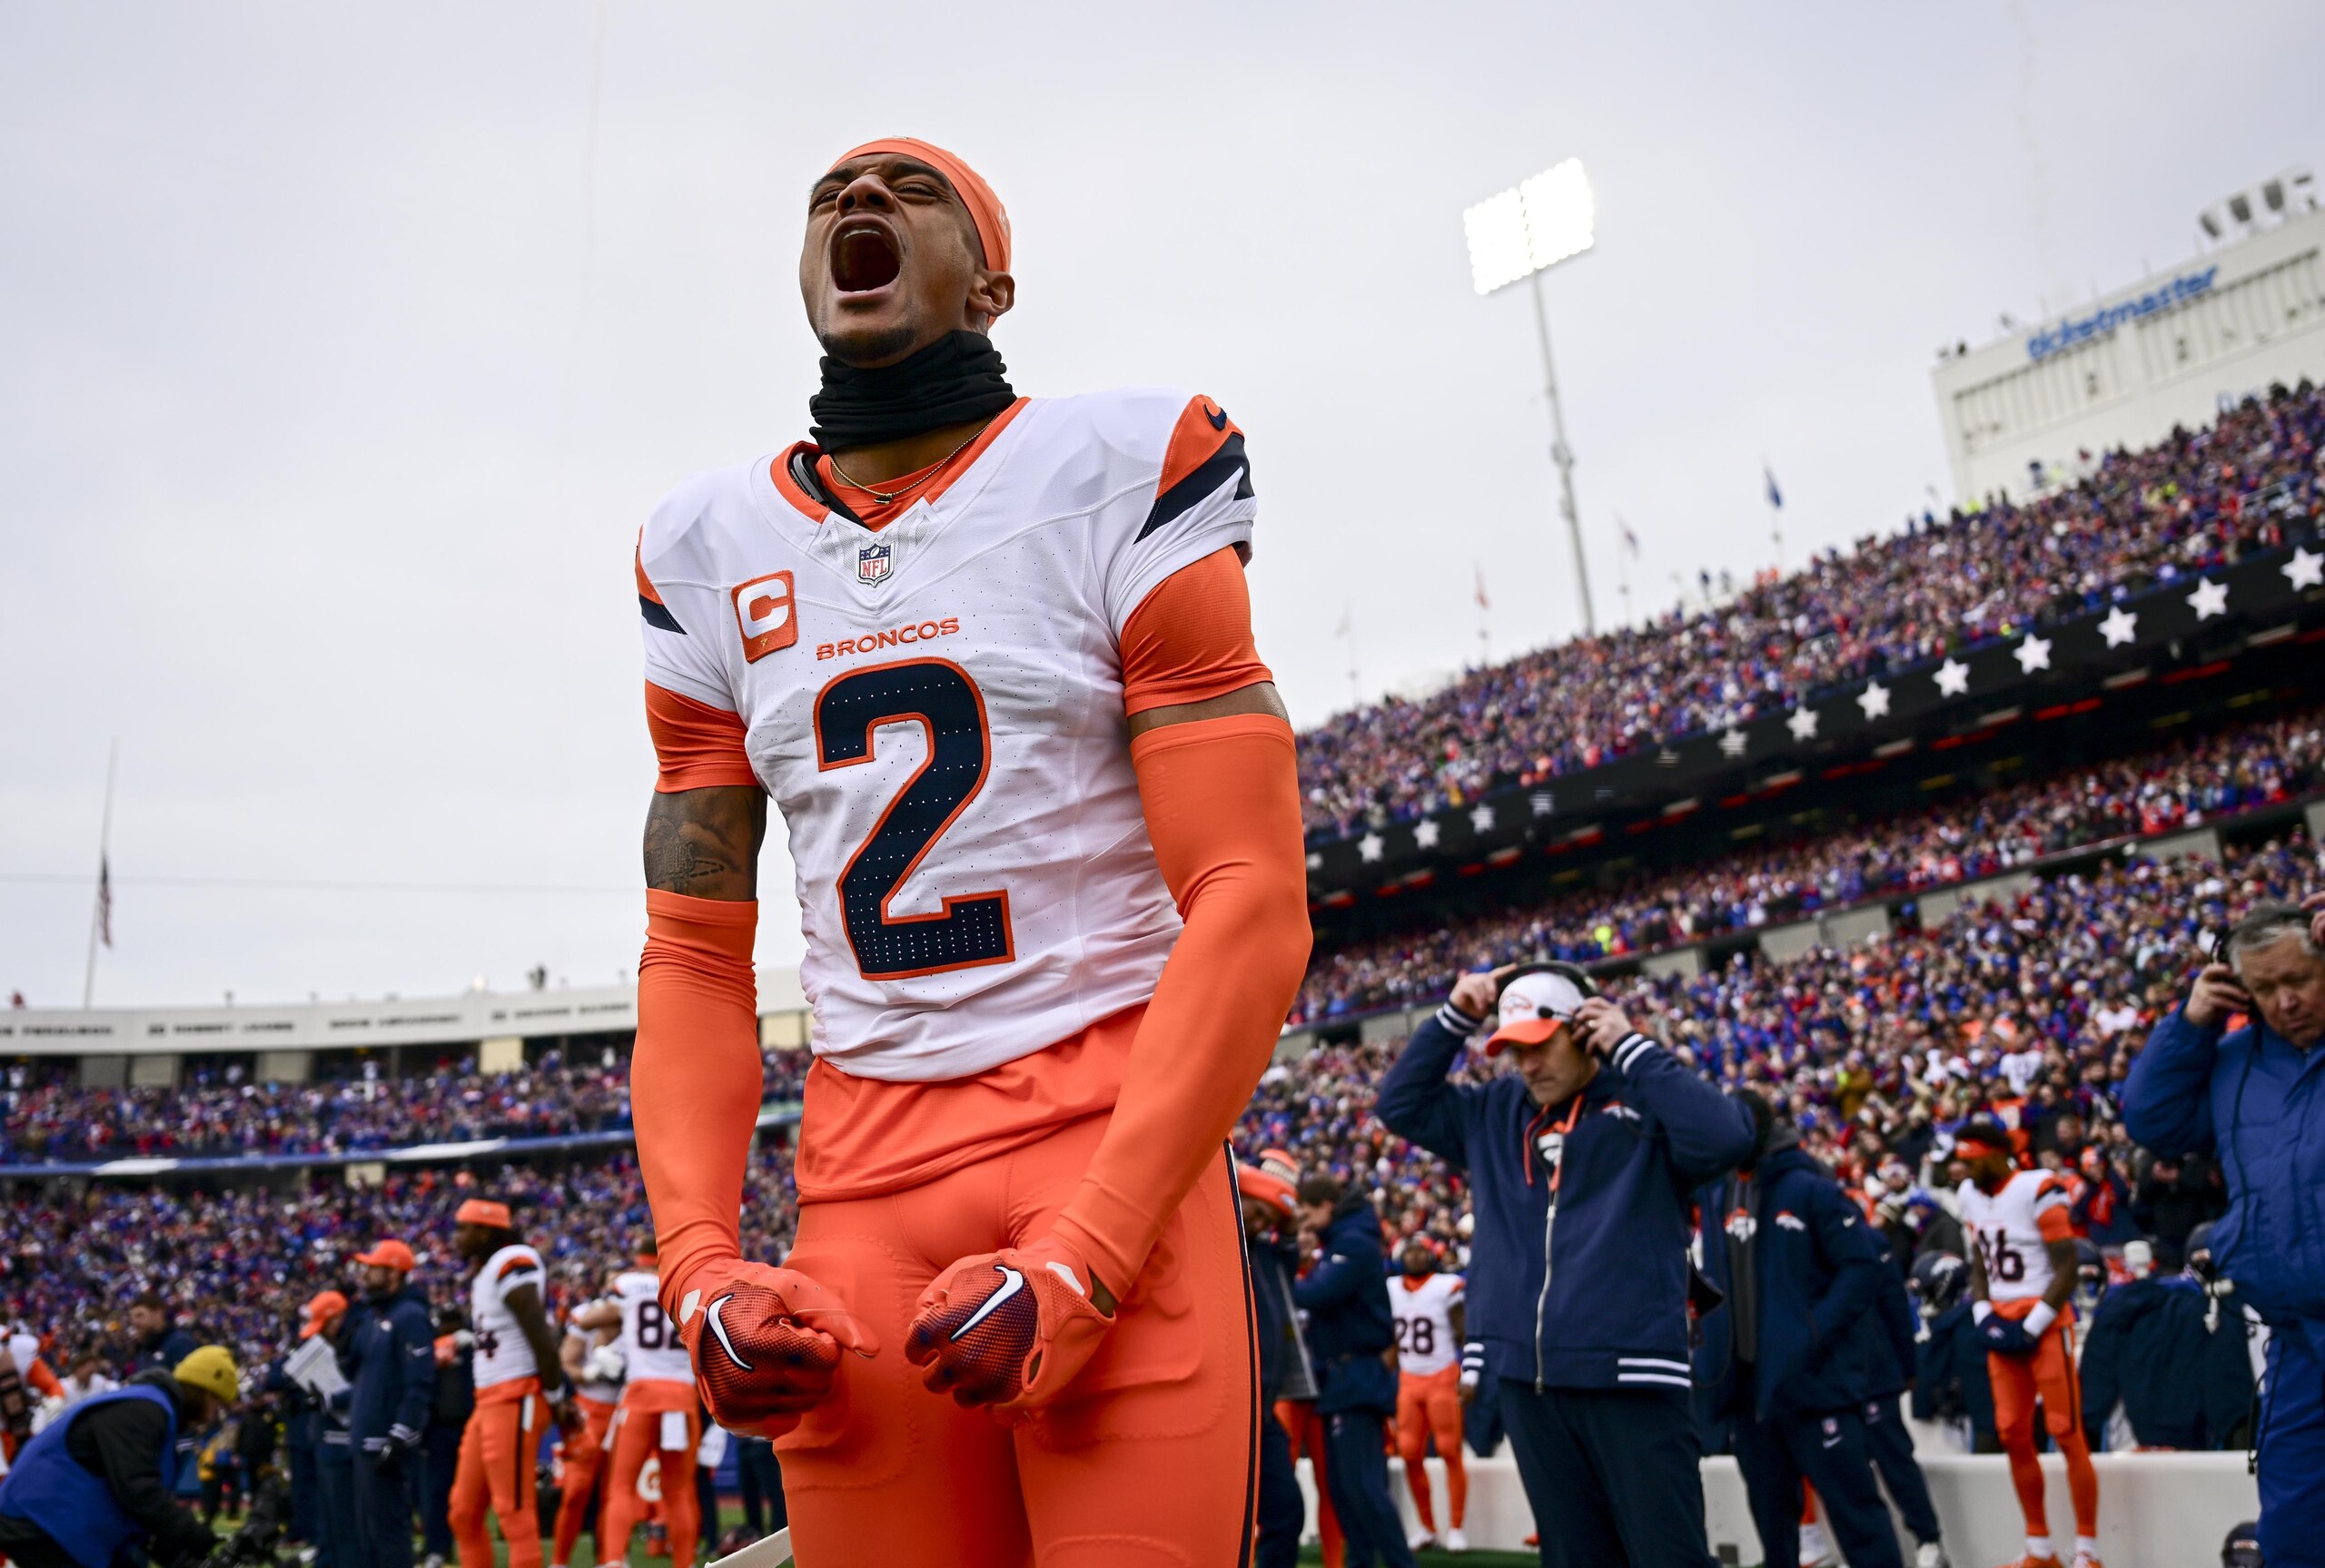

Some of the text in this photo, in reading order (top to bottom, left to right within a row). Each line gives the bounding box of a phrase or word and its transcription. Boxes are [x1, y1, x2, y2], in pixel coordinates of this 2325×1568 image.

[861, 559, 887, 578] NFL
[737, 578, 789, 639] C
[816, 616, 960, 661] BRONCOS
[813, 656, 1016, 981] 2
